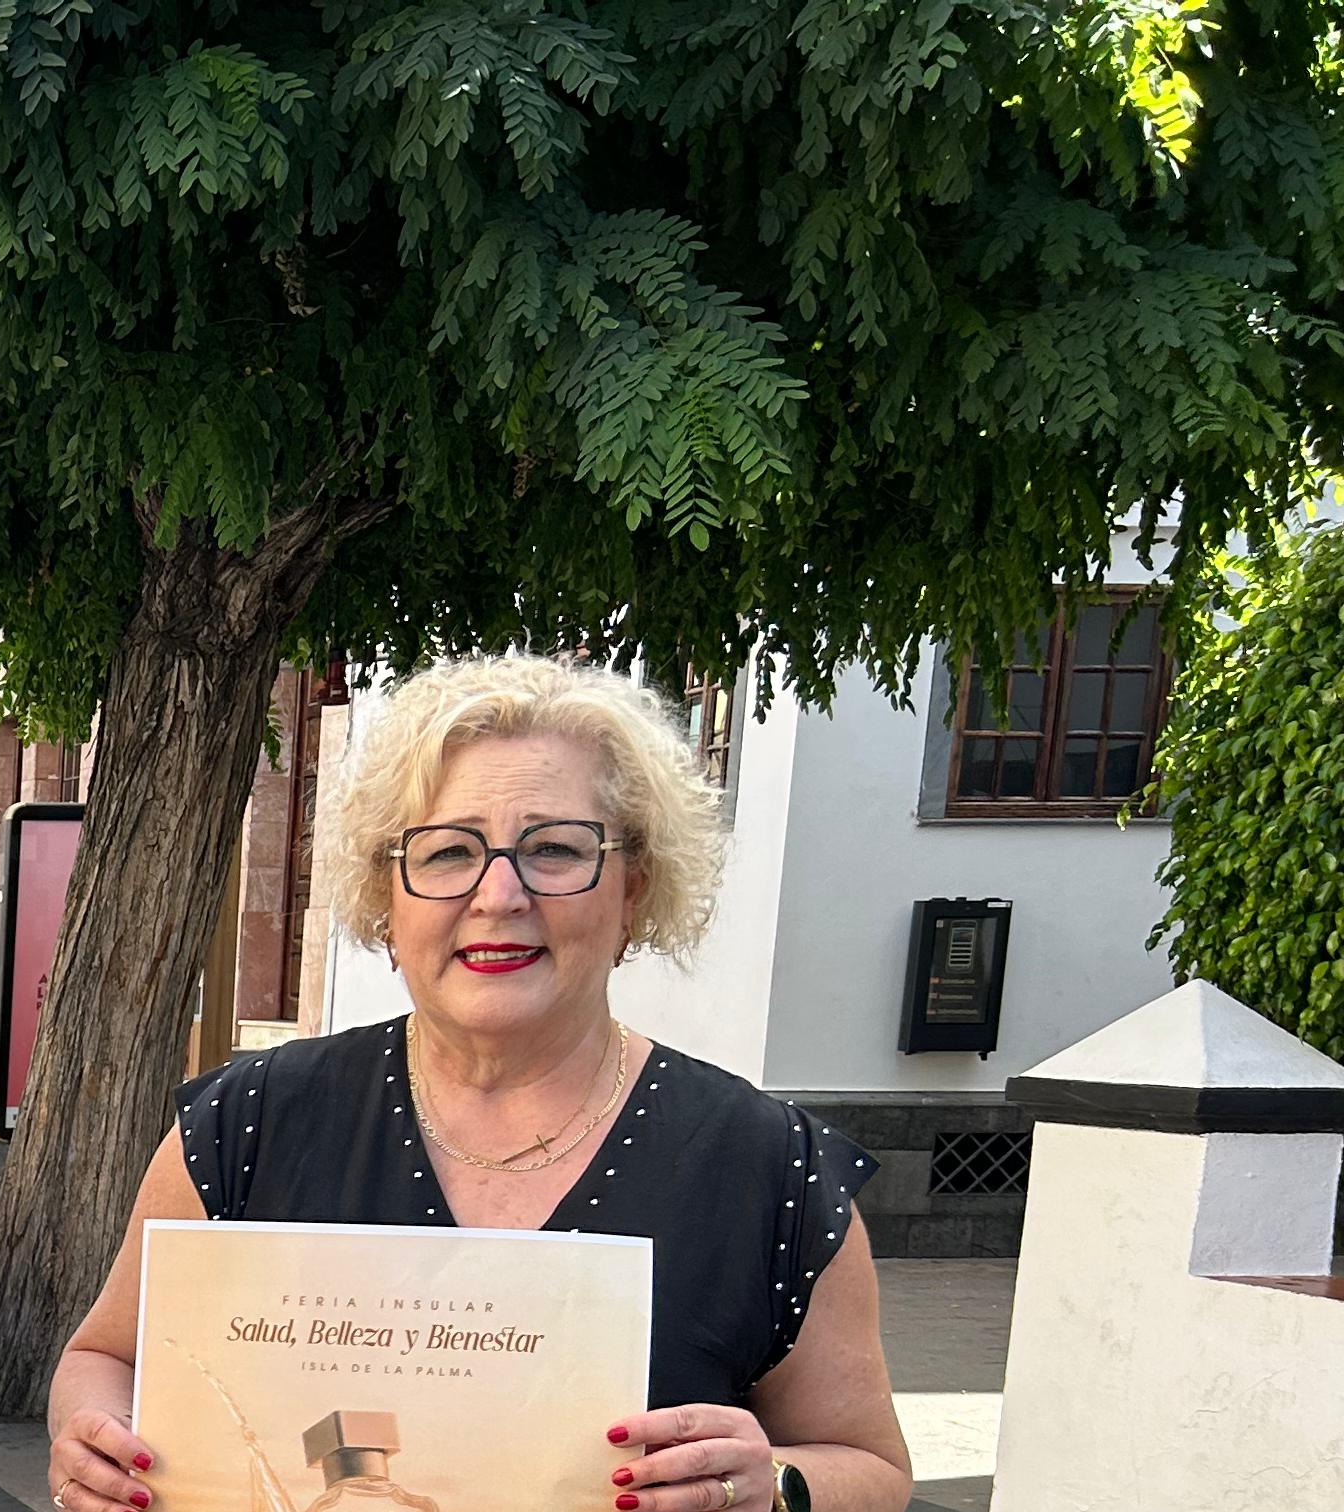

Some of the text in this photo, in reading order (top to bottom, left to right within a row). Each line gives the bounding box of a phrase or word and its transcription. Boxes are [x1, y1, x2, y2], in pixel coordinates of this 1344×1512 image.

[282, 1294, 494, 1313] FERIA INSULAR
[226, 1316, 545, 1356] Salud, Belleza y Bienestar
[301, 1361, 473, 1378] ISLA DE LA PALMA
